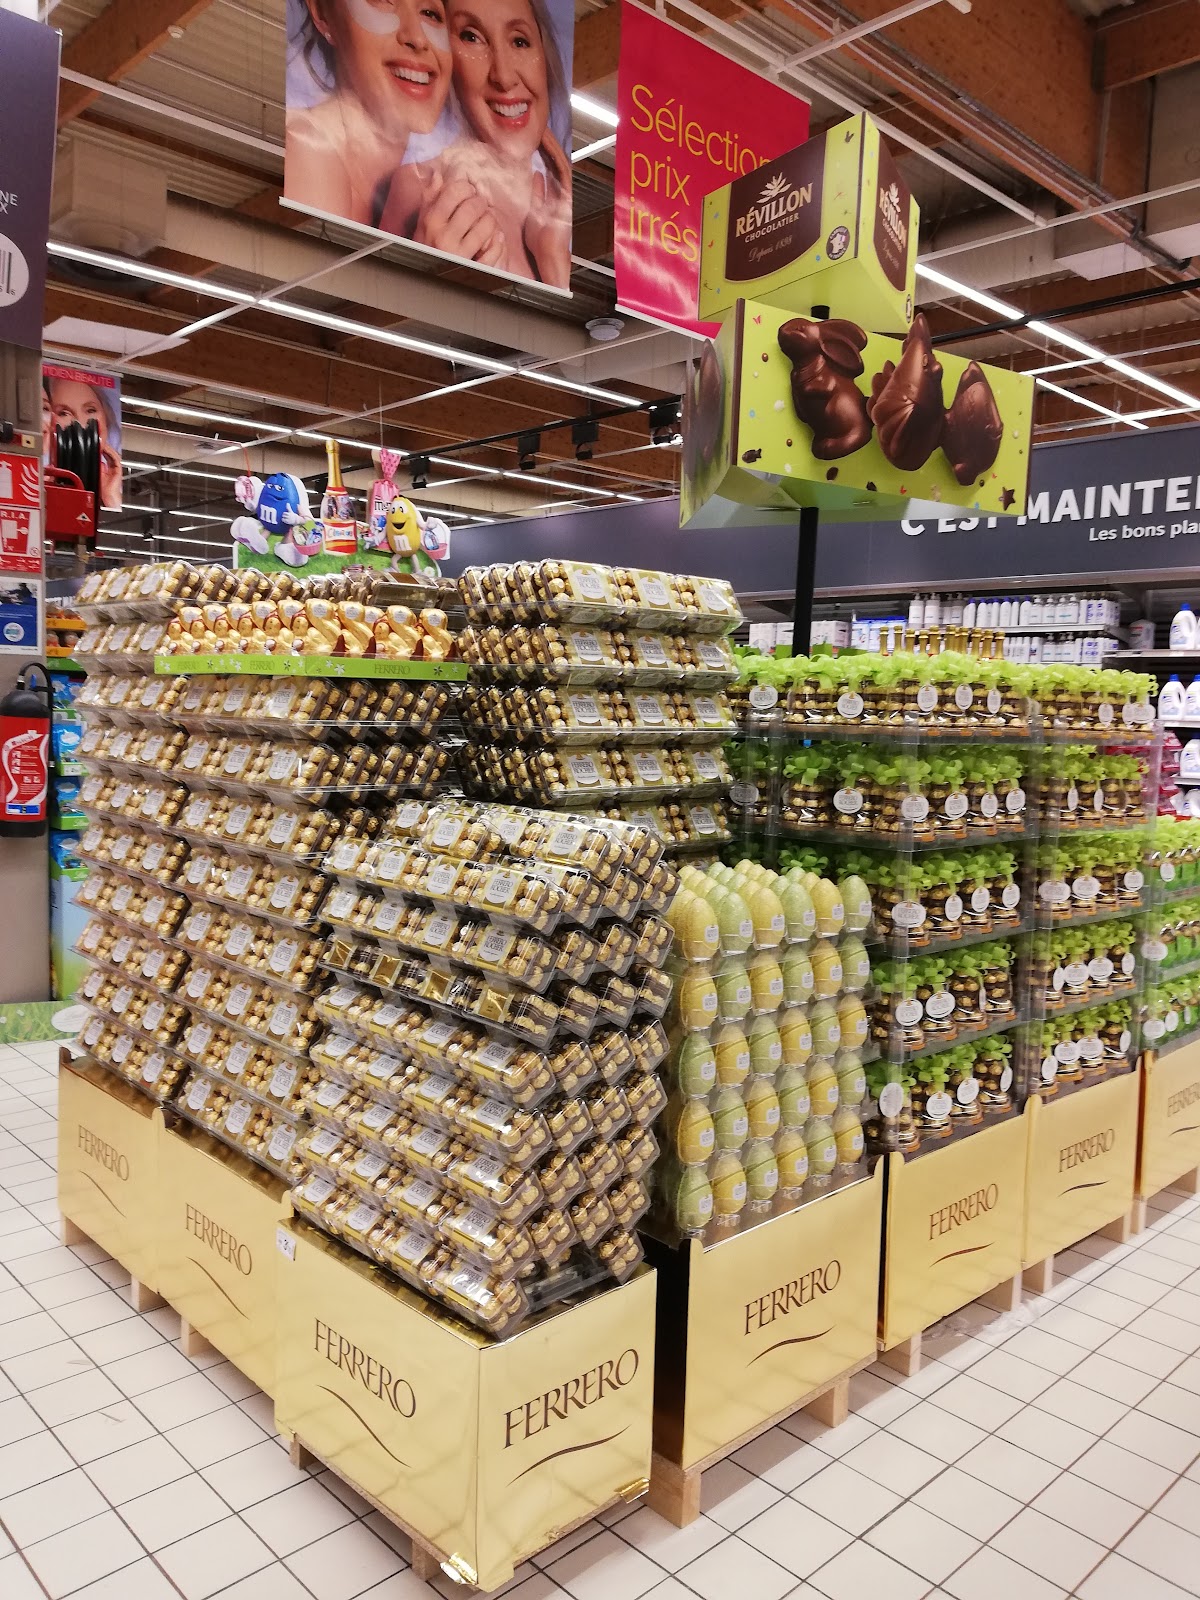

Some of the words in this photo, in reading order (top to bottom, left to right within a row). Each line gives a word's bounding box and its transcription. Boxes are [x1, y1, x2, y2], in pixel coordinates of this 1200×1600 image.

[630, 83, 771, 176] Sélectio
[630, 149, 691, 206] prix
[735, 182, 813, 238] RÉVILLON
[744, 212, 800, 244] CHOCOLATIER
[1089, 526, 1117, 542] Les
[1121, 523, 1167, 539] bons
[1169, 519, 1200, 539] pla
[374, 664, 411, 675] FERRERO
[77, 1124, 130, 1182] FERRERO
[1058, 1128, 1116, 1173] FERRERO
[185, 1202, 253, 1276] FERRERO
[929, 1183, 999, 1241] FERRERO
[744, 1259, 842, 1336] FERRERO
[313, 1318, 417, 1419] FERRERO
[503, 1348, 639, 1448] FERRERO
